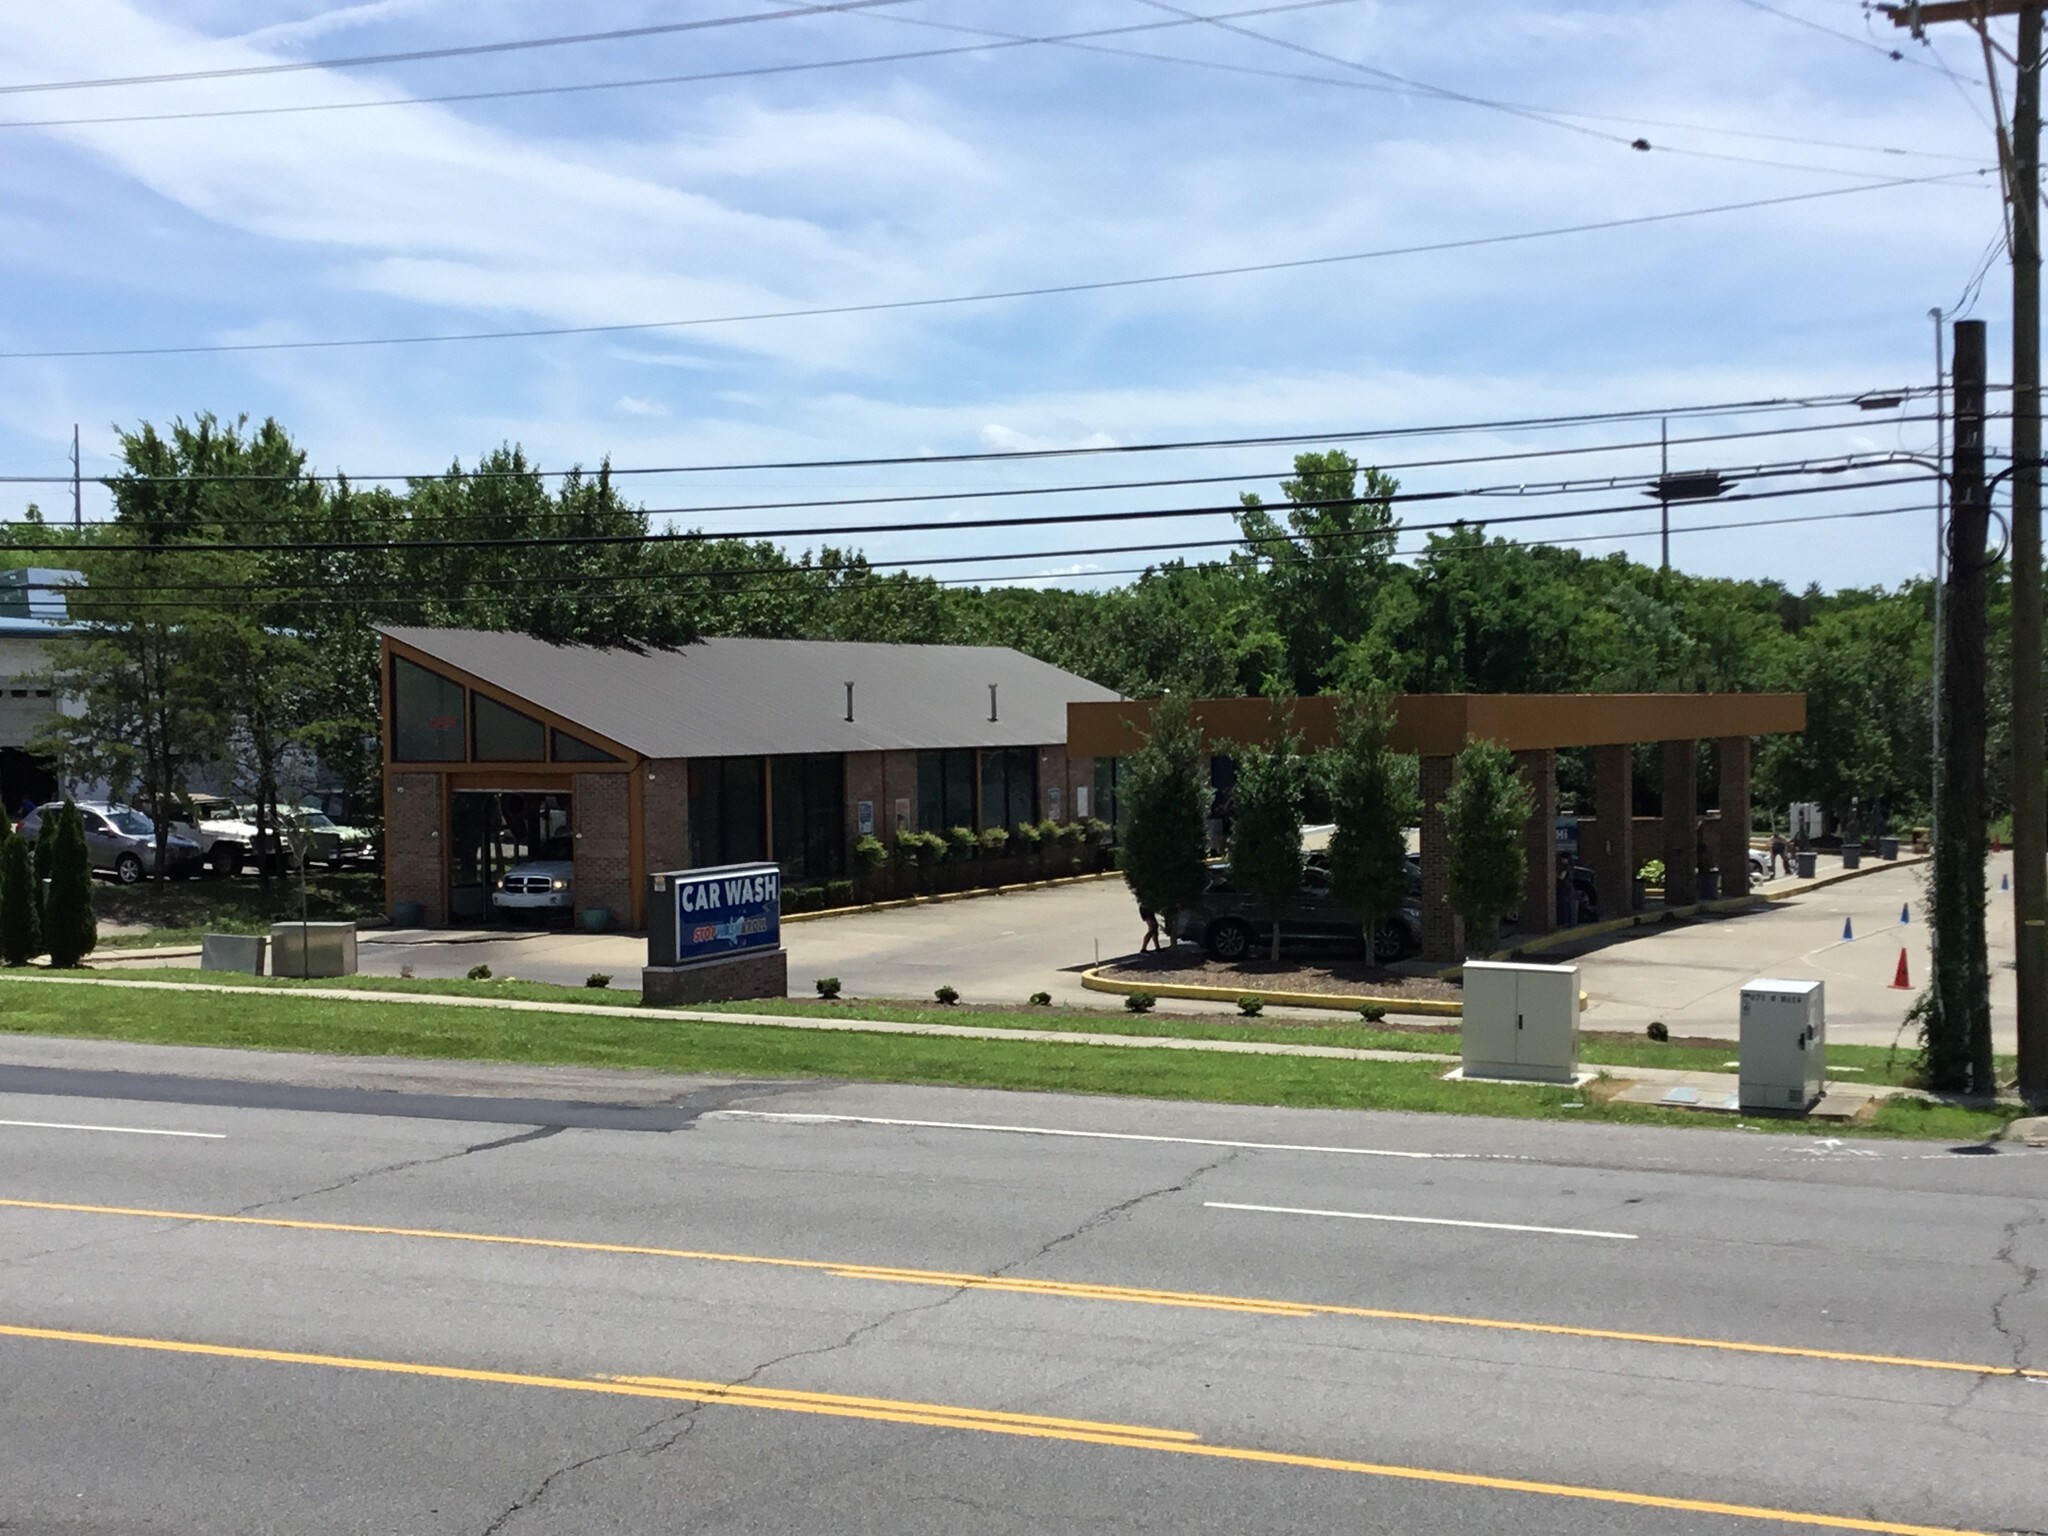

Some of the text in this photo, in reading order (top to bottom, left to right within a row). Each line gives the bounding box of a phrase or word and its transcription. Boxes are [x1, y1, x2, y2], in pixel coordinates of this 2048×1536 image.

[682, 883, 721, 913] CAR
[724, 876, 777, 906] WASH
[692, 926, 716, 943] STOP
